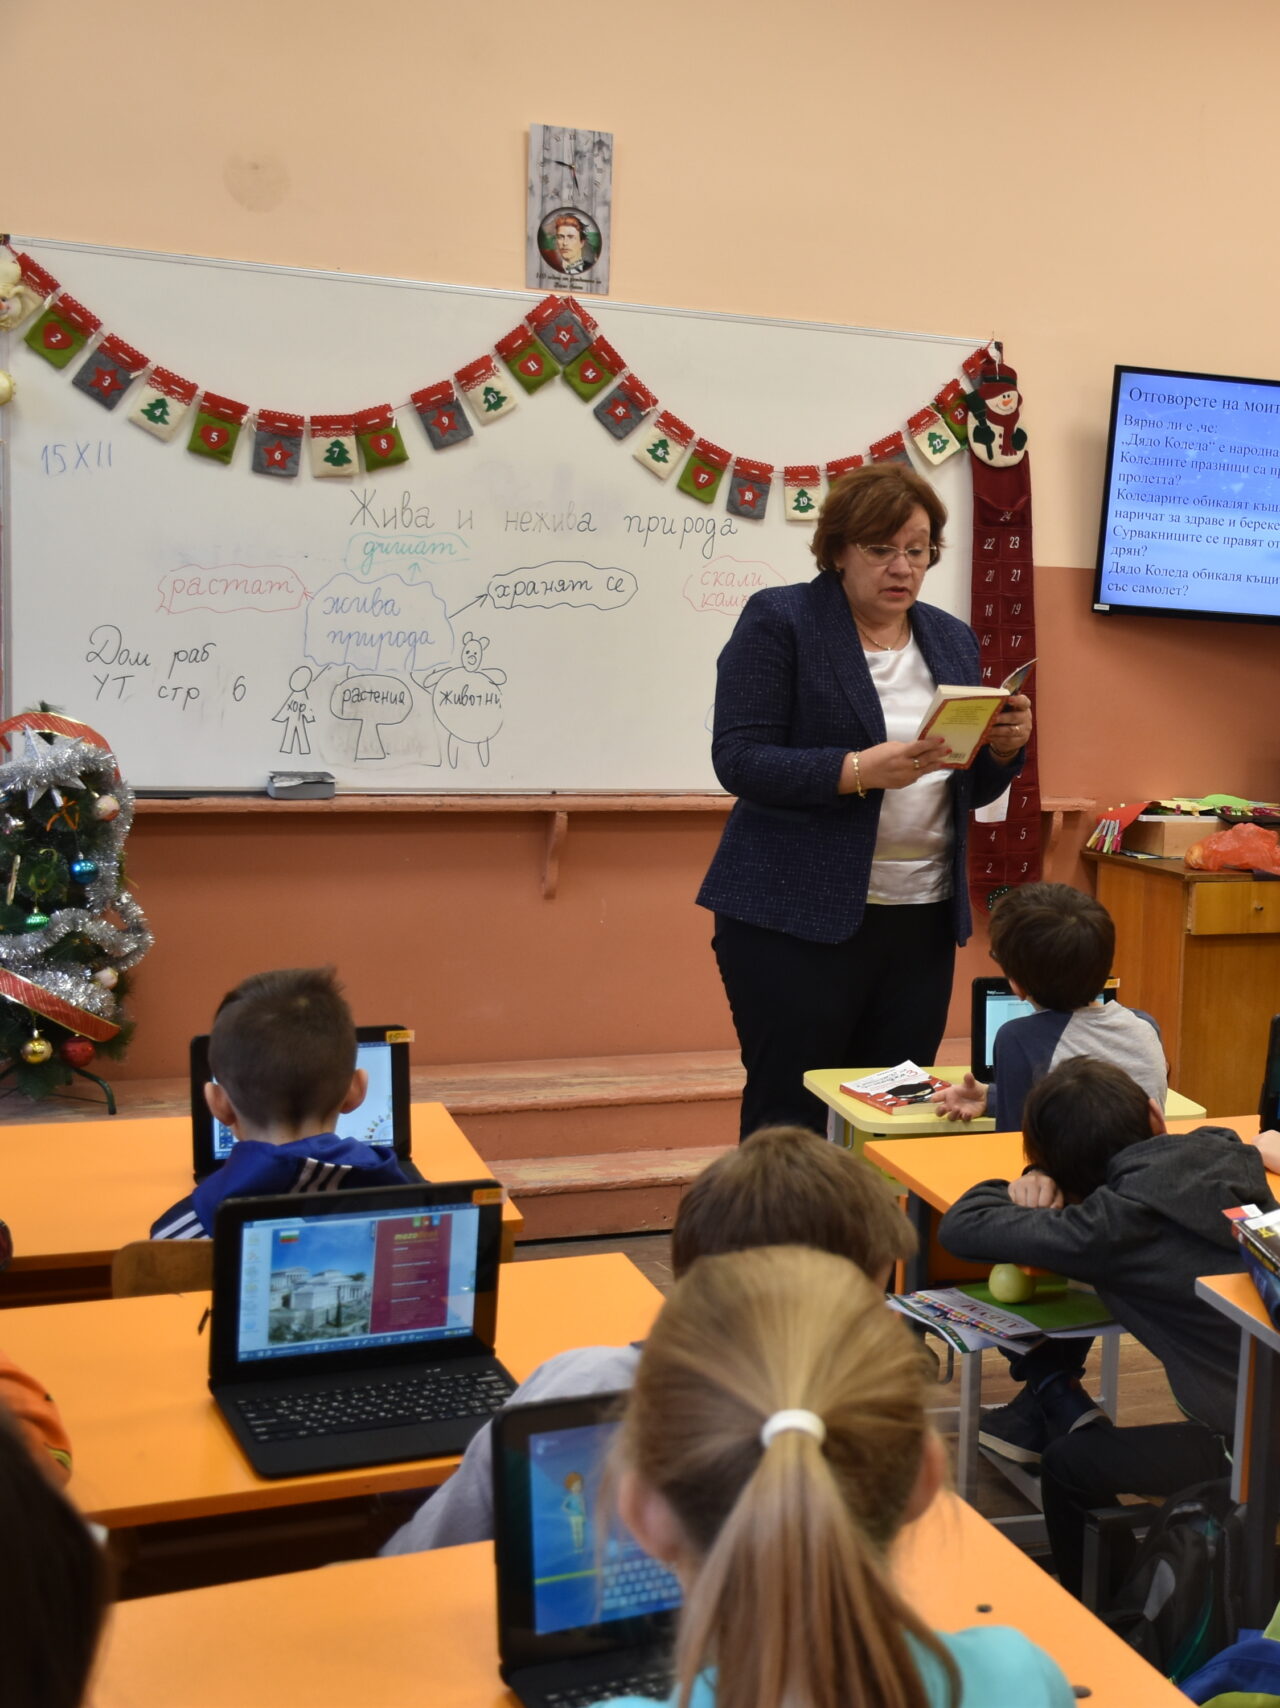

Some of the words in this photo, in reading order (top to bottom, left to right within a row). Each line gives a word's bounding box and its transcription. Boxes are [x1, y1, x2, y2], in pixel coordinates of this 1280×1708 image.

[51, 333, 62, 343] 2
[559, 330, 570, 342] 12
[527, 360, 538, 371] 11
[102, 376, 112, 386] 3
[486, 392, 497, 404] 10
[1129, 386, 1217, 410] Отговорете
[1222, 399, 1239, 411] на
[153, 407, 163, 417] 4
[954, 408, 965, 420] 23
[441, 416, 449, 426] 9
[1123, 413, 1163, 431] Вярно
[1166, 420, 1182, 431] ли
[210, 432, 219, 443] 5
[380, 438, 388, 449] 8
[274, 450, 282, 461] 6
[333, 448, 340, 458] 7
[656, 447, 666, 458] 16
[1218, 443, 1226, 453] е
[1229, 444, 1280, 459] народна
[1120, 451, 1187, 468] Коледните
[1190, 459, 1250, 474] празници
[1253, 465, 1267, 475] са
[699, 473, 709, 484] 17
[1118, 471, 1182, 487] пролетта?
[799, 496, 808, 508] 19
[1116, 487, 1189, 506] Коледарите
[1192, 494, 1250, 510] обикалят
[349, 488, 436, 531] Жива
[457, 507, 474, 530] и
[504, 500, 598, 534] нежива
[623, 514, 738, 560] природа
[1114, 508, 1165, 522] наричат
[1168, 513, 1181, 523] за
[1184, 515, 1225, 527] здраве
[1228, 518, 1236, 528] и
[984, 537, 996, 550] 22
[1009, 536, 1020, 549] 23
[1112, 524, 1202, 543] Сурвакниците
[1205, 534, 1219, 545] се
[1222, 535, 1264, 549] правят
[1267, 539, 1280, 549] от
[1111, 545, 1148, 558] дрян?
[1010, 569, 1021, 582] 21
[1109, 561, 1141, 575] Дядо
[1145, 563, 1189, 579] Коледа
[1192, 568, 1242, 582] обикаля
[168, 577, 294, 615] растат
[494, 578, 593, 609] хранят
[606, 573, 626, 593] се
[1107, 582, 1128, 593] със
[1131, 583, 1189, 597] самолет?
[322, 586, 401, 617] жива
[1011, 603, 1022, 615] 19
[1011, 635, 1022, 648] 17
[86, 624, 151, 667] Дом
[168, 642, 217, 679] раб
[327, 630, 436, 672] природа
[982, 665, 992, 679] 14
[93, 673, 135, 701] УТ
[158, 685, 200, 711] стр
[232, 675, 246, 701] 6
[341, 687, 405, 716] растения
[1021, 796, 1028, 809] 7
[990, 830, 996, 842] 4
[1020, 828, 1027, 840] 5
[986, 862, 993, 874] 2
[1021, 862, 1028, 873] 3
